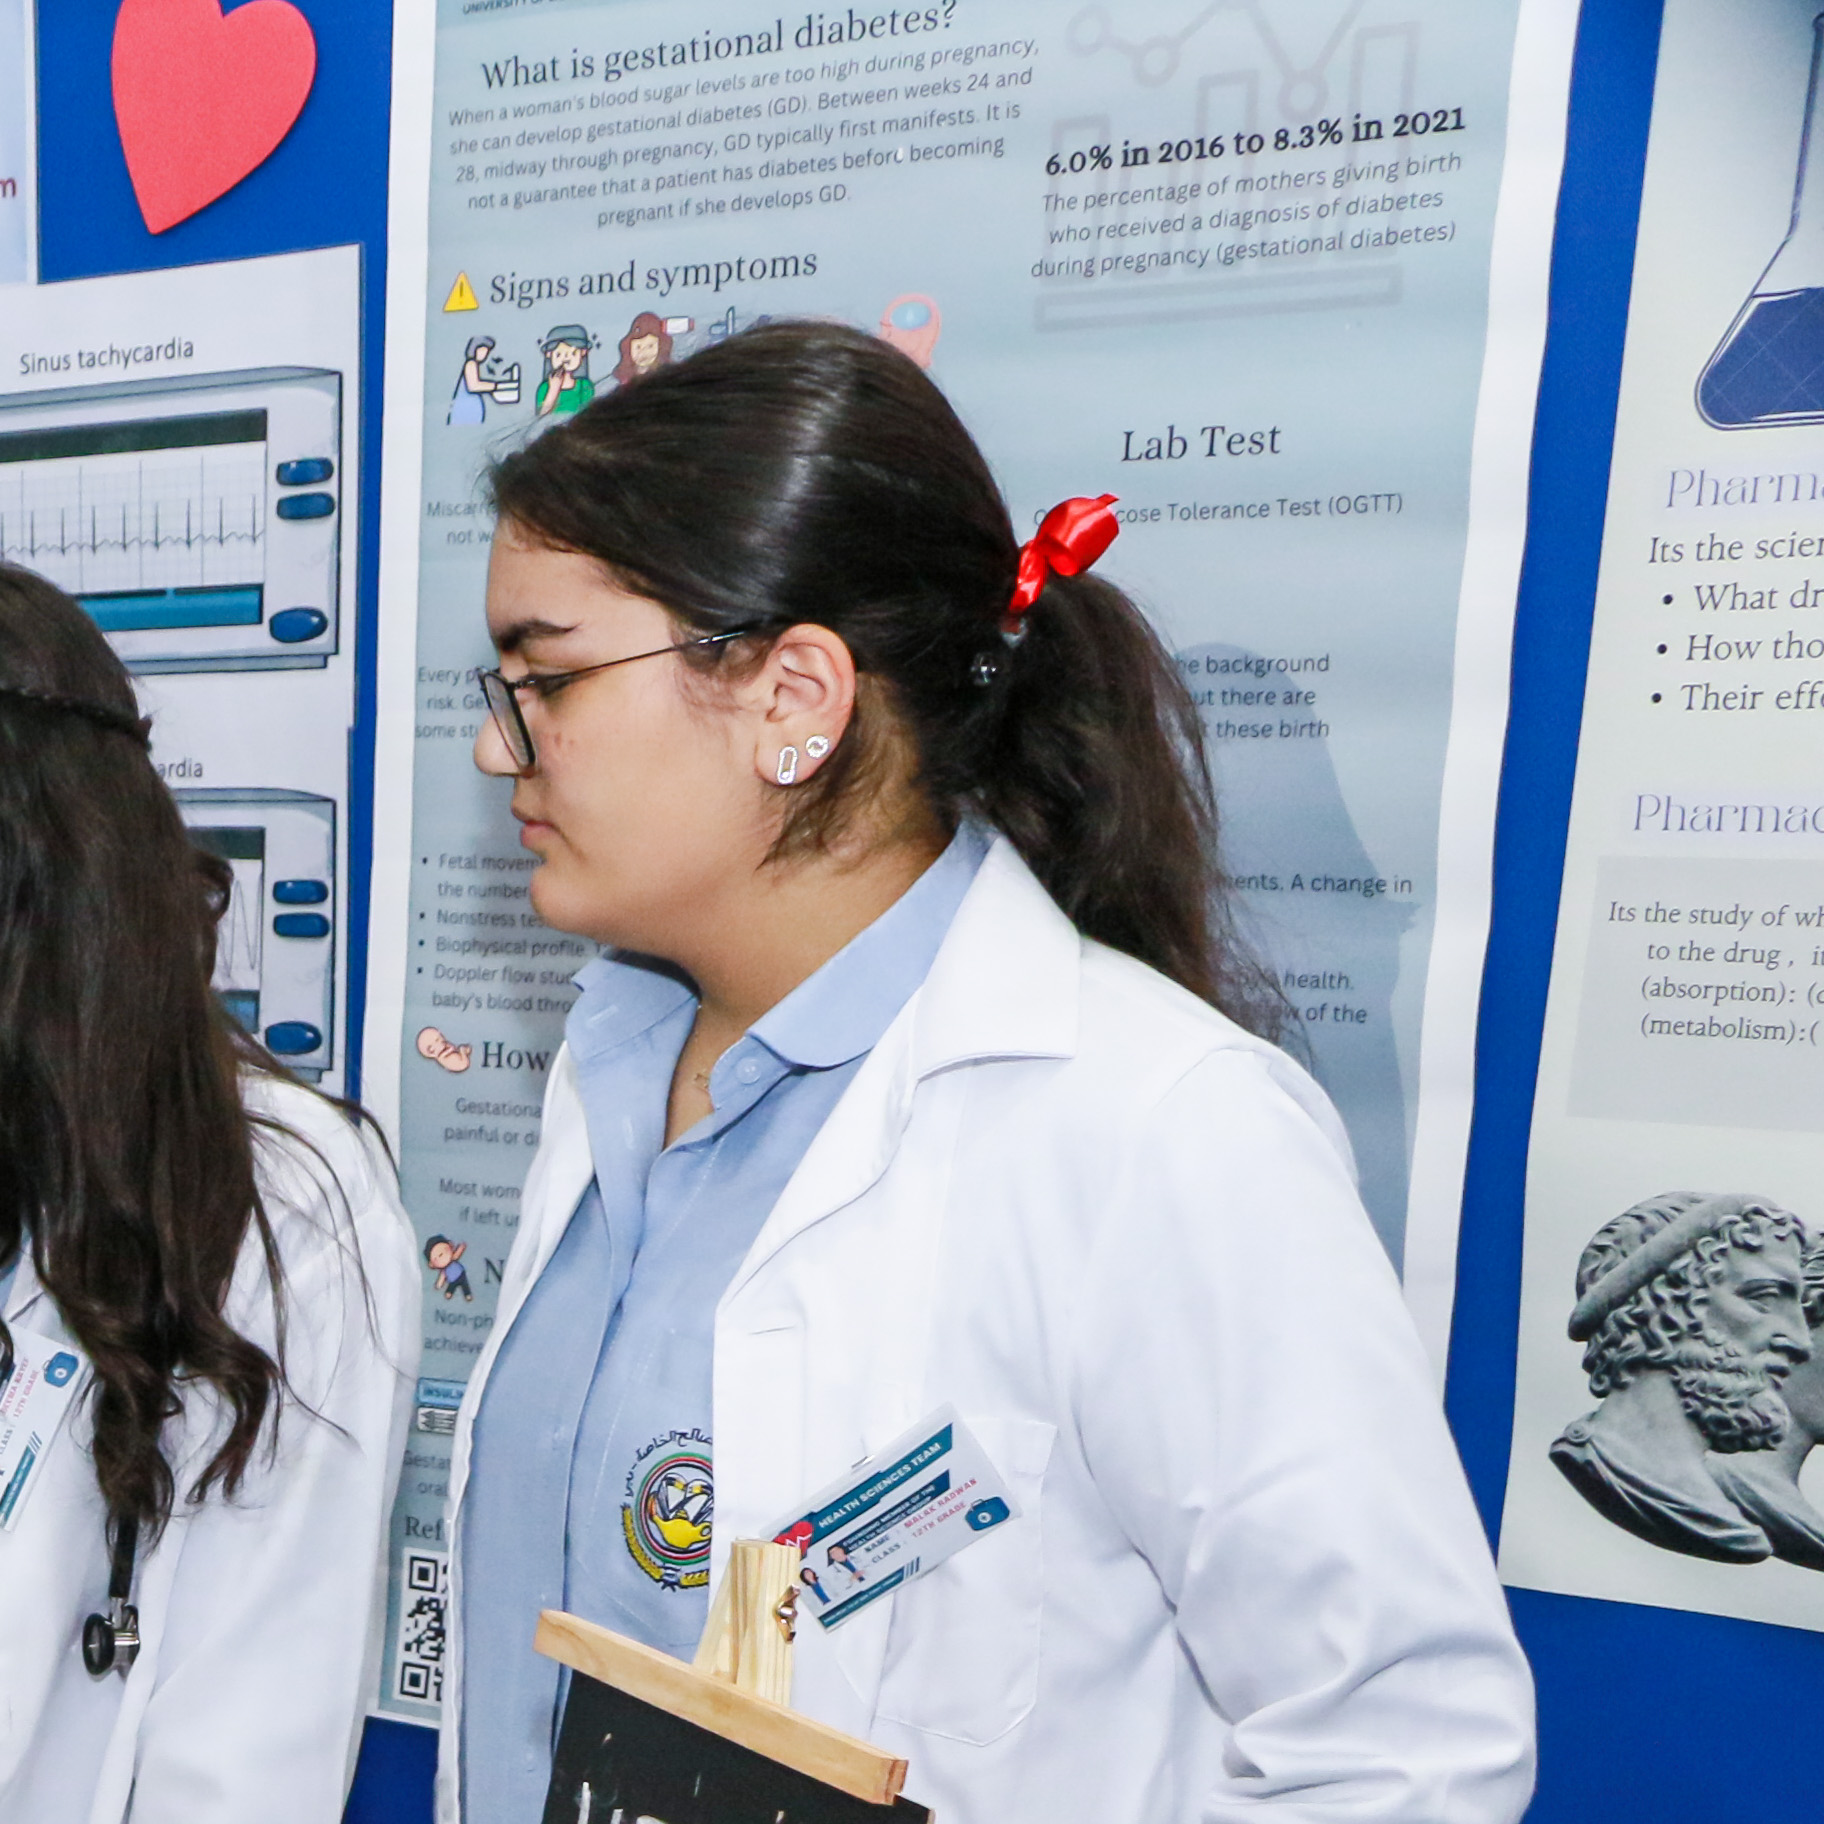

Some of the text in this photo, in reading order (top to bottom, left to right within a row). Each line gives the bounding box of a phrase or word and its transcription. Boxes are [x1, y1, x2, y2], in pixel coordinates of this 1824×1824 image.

[482, 0, 957, 89] What is gestational diabetes?
[449, 108, 494, 126] When
[499, 107, 508, 120] a
[513, 96, 584, 118] woman's
[590, 86, 638, 109] blood
[644, 84, 692, 104] sugar
[696, 74, 746, 95] levels
[750, 72, 780, 88] are
[785, 68, 815, 84] too
[820, 58, 859, 82] high
[865, 52, 926, 74] during
[450, 139, 478, 155] she
[482, 136, 510, 151] can
[516, 126, 582, 146] develop
[586, 110, 681, 144] gestational
[686, 104, 762, 126] diabetes
[818, 88, 898, 110] Between
[904, 77, 962, 100] weeks
[966, 72, 990, 92] 24
[996, 66, 1032, 88] and
[484, 160, 546, 178] midway
[552, 148, 618, 172] through
[724, 132, 751, 152] GD
[757, 124, 834, 153] typically
[840, 120, 876, 138] first
[987, 104, 1000, 121] It
[1006, 101, 1020, 118] is
[1046, 108, 1466, 176] 6.0% in 2016 to 8.3% in 2021
[468, 194, 494, 209] not
[500, 194, 508, 206] a
[514, 184, 596, 210] guarantee
[602, 178, 636, 196] that
[641, 178, 650, 192] a
[656, 169, 718, 194] patient
[723, 166, 753, 182] has
[758, 157, 838, 179] diabetes
[910, 136, 1004, 162] becoming
[1042, 152, 1461, 213] The percentage of mothers giving birth
[598, 204, 674, 228] pregnant
[680, 198, 692, 216] if
[696, 198, 726, 216] she
[731, 190, 813, 212] develops
[1050, 192, 1443, 244] who received a diagnosis of diabetes
[1031, 221, 1456, 278] during pregnancy (gestational diabetes)
[490, 254, 817, 308] Signs and symptoms
[20, 338, 194, 375] Sinus tachycardia
[1122, 424, 1280, 462] Lab Test
[1666, 470, 1824, 508] Pharm
[1115, 493, 1402, 524] cose Tolerance Test (OGTT)
[1648, 532, 1744, 563] Its the
[1694, 582, 1778, 610] What
[1686, 634, 1762, 660] How
[1206, 653, 1330, 678] background
[1220, 688, 1316, 706] there are
[1681, 682, 1764, 710] Their
[1216, 720, 1330, 738] these birth
[1290, 874, 1412, 898] A change in
[1608, 902, 1636, 922] Its
[1645, 902, 1681, 923] the
[1688, 904, 1754, 932] study
[1761, 904, 1790, 926] of
[1648, 940, 1781, 970] to the drug
[1642, 976, 1795, 1006] (absorption):
[1306, 1003, 1368, 1024] of the
[482, 1042, 550, 1071] How
[456, 1097, 542, 1119] Gestationa
[818, 1498, 860, 1529] HEALTH
[861, 1464, 912, 1503] SCIENCES
[910, 1441, 942, 1469] TEAM
